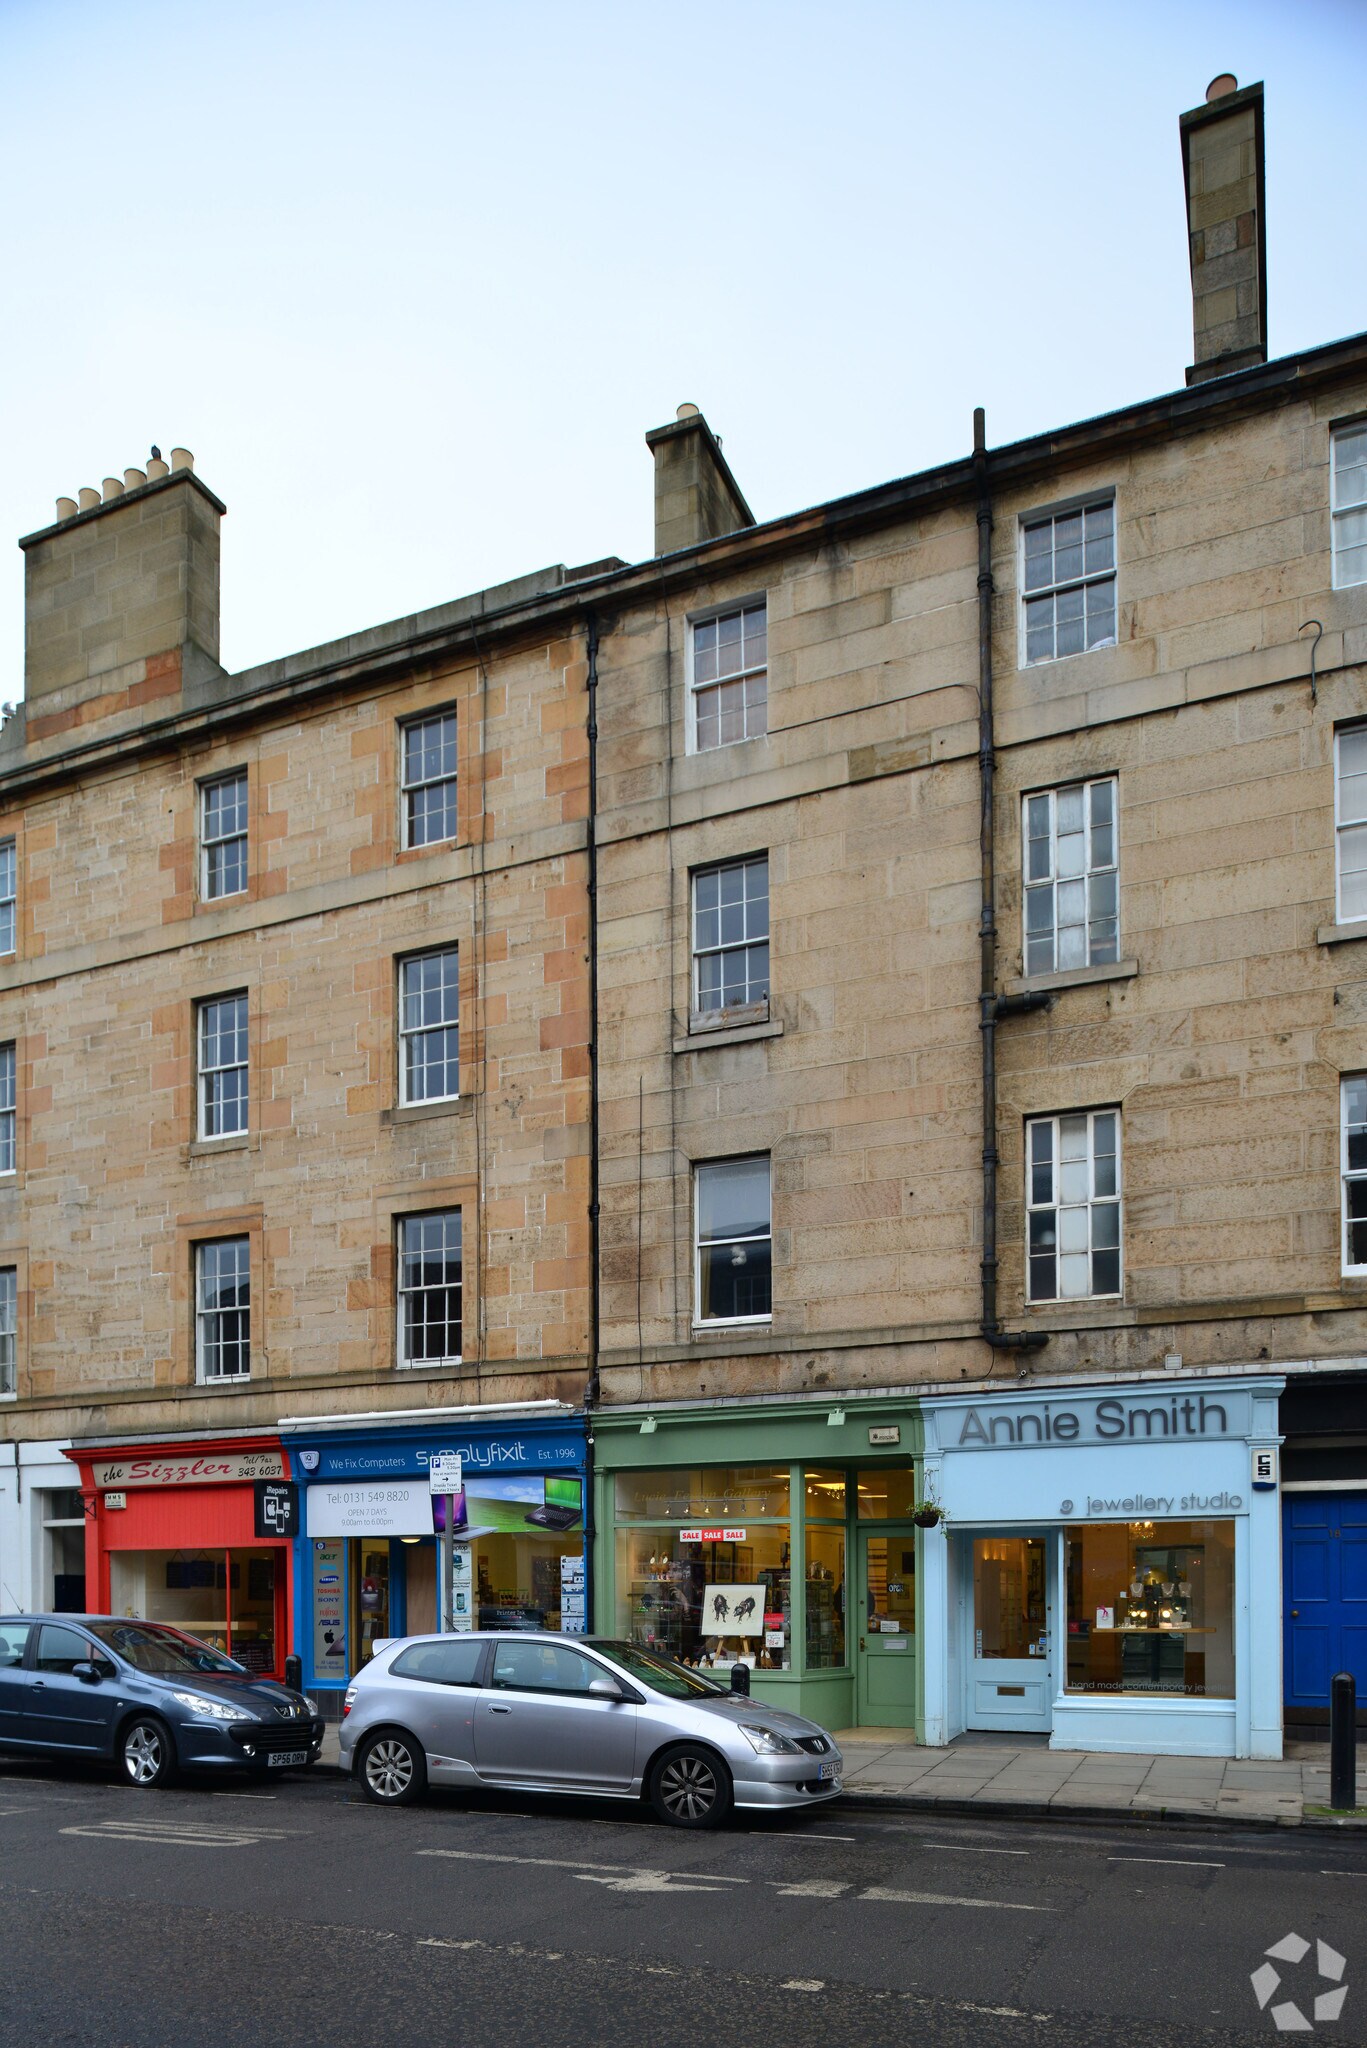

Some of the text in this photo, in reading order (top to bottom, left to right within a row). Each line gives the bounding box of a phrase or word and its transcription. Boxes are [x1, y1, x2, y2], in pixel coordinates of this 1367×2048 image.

[959, 1396, 1228, 1445] Annie Smith
[538, 1448, 576, 1460] Est. 1996
[329, 1457, 406, 1469] We Fix Computers
[433, 1458, 440, 1468] P
[103, 1459, 233, 1483] the Sizzler
[238, 1466, 282, 1477] 343 6037
[266, 1485, 288, 1495] iRepairs
[327, 1491, 409, 1504] Tel: 0131 549 8820
[1086, 1492, 1242, 1516] jewellery studio
[348, 1508, 365, 1516] OPEN
[371, 1508, 387, 1516] DAYS
[341, 1519, 362, 1527] 9.00am
[371, 1519, 394, 1527] 6.00pm
[1071, 1681, 1095, 1690] hand
[1097, 1681, 1125, 1690] made
[1126, 1682, 1193, 1693] contemporary
[272, 1754, 291, 1765] SP56
